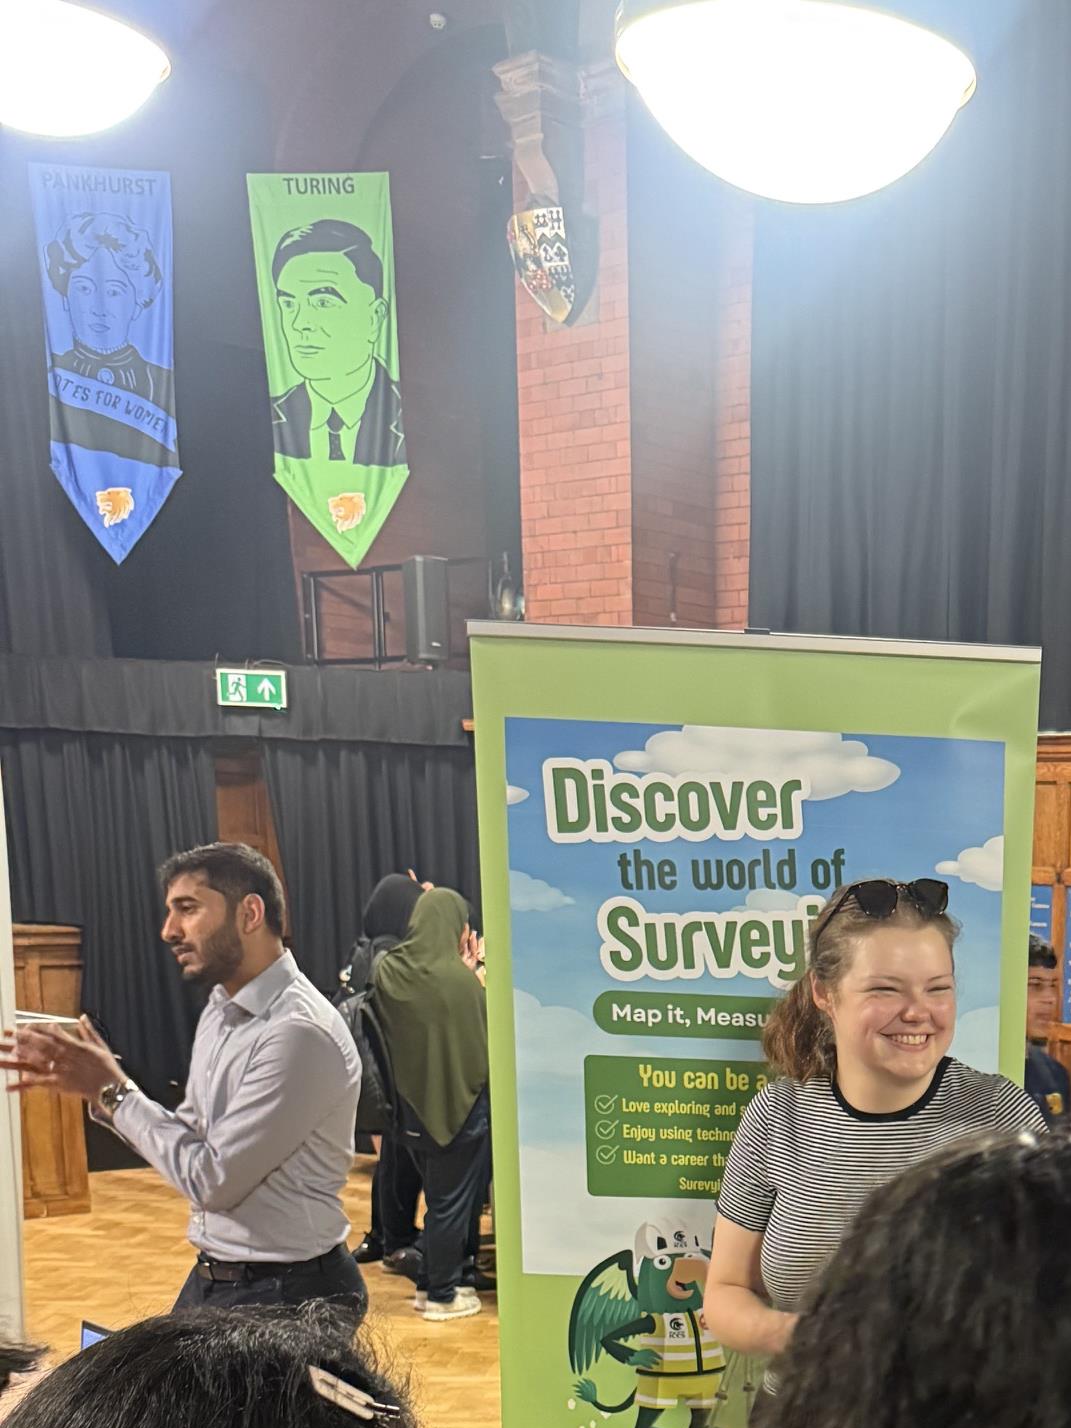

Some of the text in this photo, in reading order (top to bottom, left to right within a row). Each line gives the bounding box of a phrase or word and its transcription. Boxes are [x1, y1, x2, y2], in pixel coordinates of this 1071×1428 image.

[41, 171, 157, 196] PANKHURST
[282, 176, 355, 196] TURING
[95, 389, 122, 410] FOR
[551, 766, 803, 834] Discover
[617, 848, 846, 891] the world of
[612, 1003, 662, 1028] Map
[667, 1004, 691, 1028] it,
[639, 1064, 676, 1089] You
[683, 1071, 719, 1090] can
[725, 1068, 749, 1091] be
[622, 1098, 650, 1113] Love
[653, 1099, 711, 1118] exploring
[714, 1102, 737, 1116] and
[622, 1124, 656, 1142] Enjoy
[659, 1126, 693, 1143] using
[623, 1150, 656, 1165] Want
[659, 1154, 668, 1165] a
[671, 1153, 709, 1167] career
